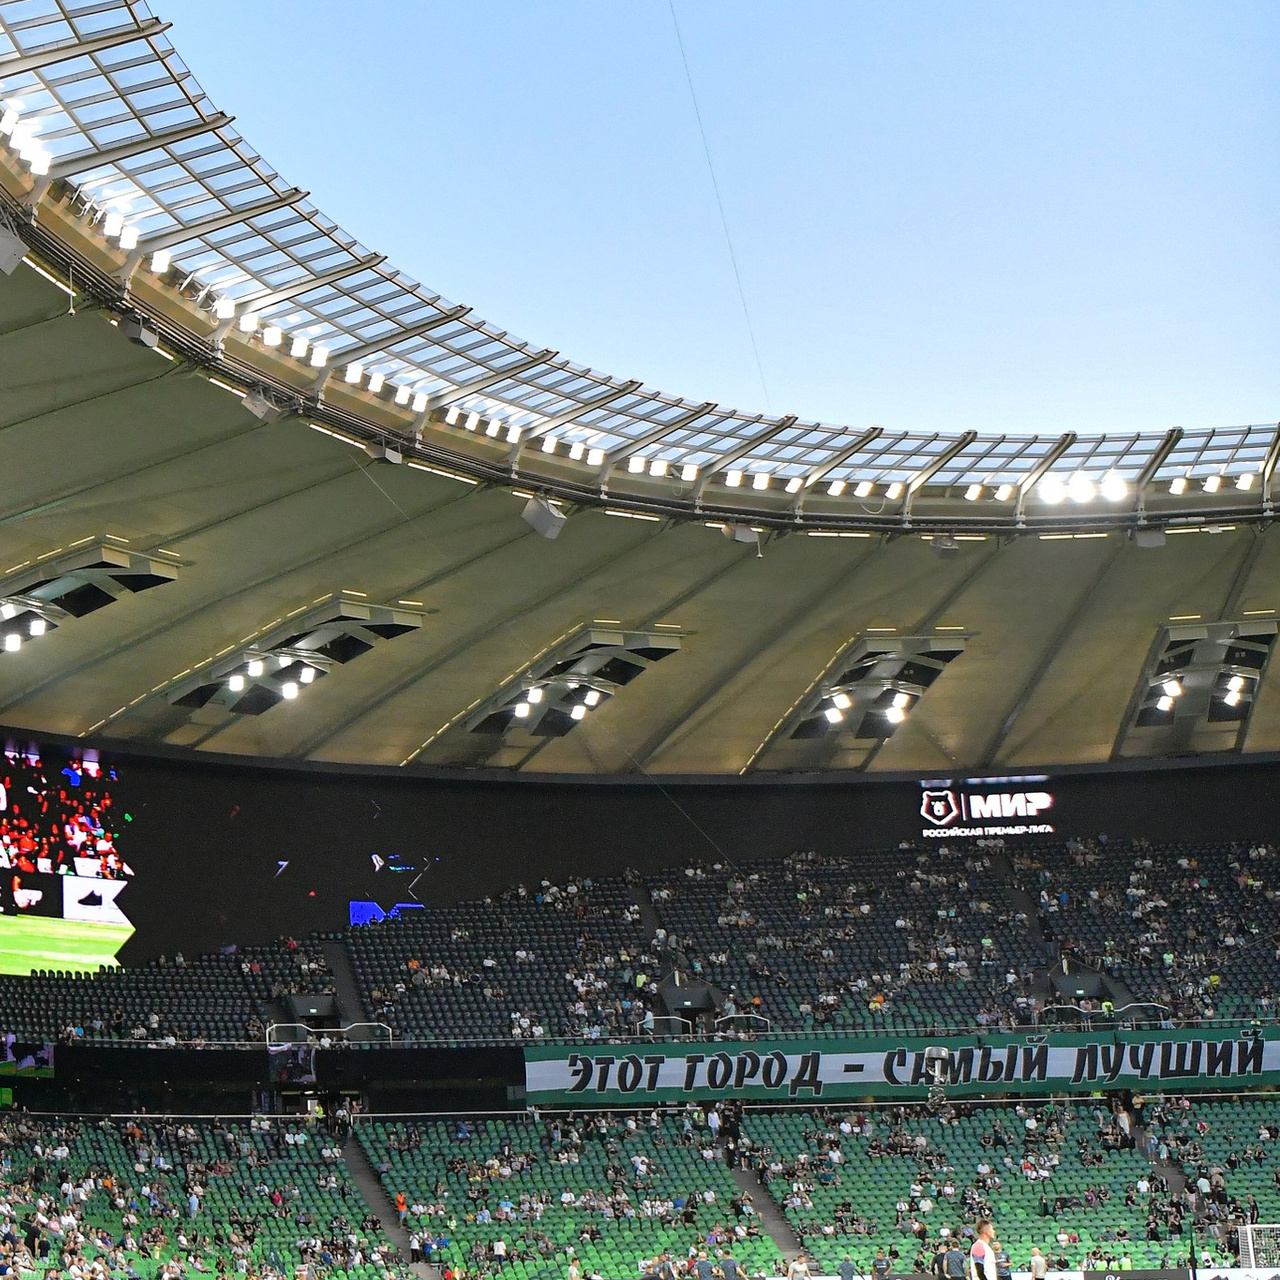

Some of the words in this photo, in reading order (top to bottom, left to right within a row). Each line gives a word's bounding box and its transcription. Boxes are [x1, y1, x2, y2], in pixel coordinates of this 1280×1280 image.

[969, 791, 1053, 819] МИР
[922, 826, 984, 838] РОССИЙСКАЯ
[984, 824, 1055, 836] ПРЕМЬЕР-ЛИГА
[568, 1053, 666, 1093] ЭТОТ
[683, 1050, 824, 1096] ГОРОД
[881, 1034, 1050, 1087] САМЫЙ
[1070, 1029, 1264, 1084] ЛУЧШИЙ
